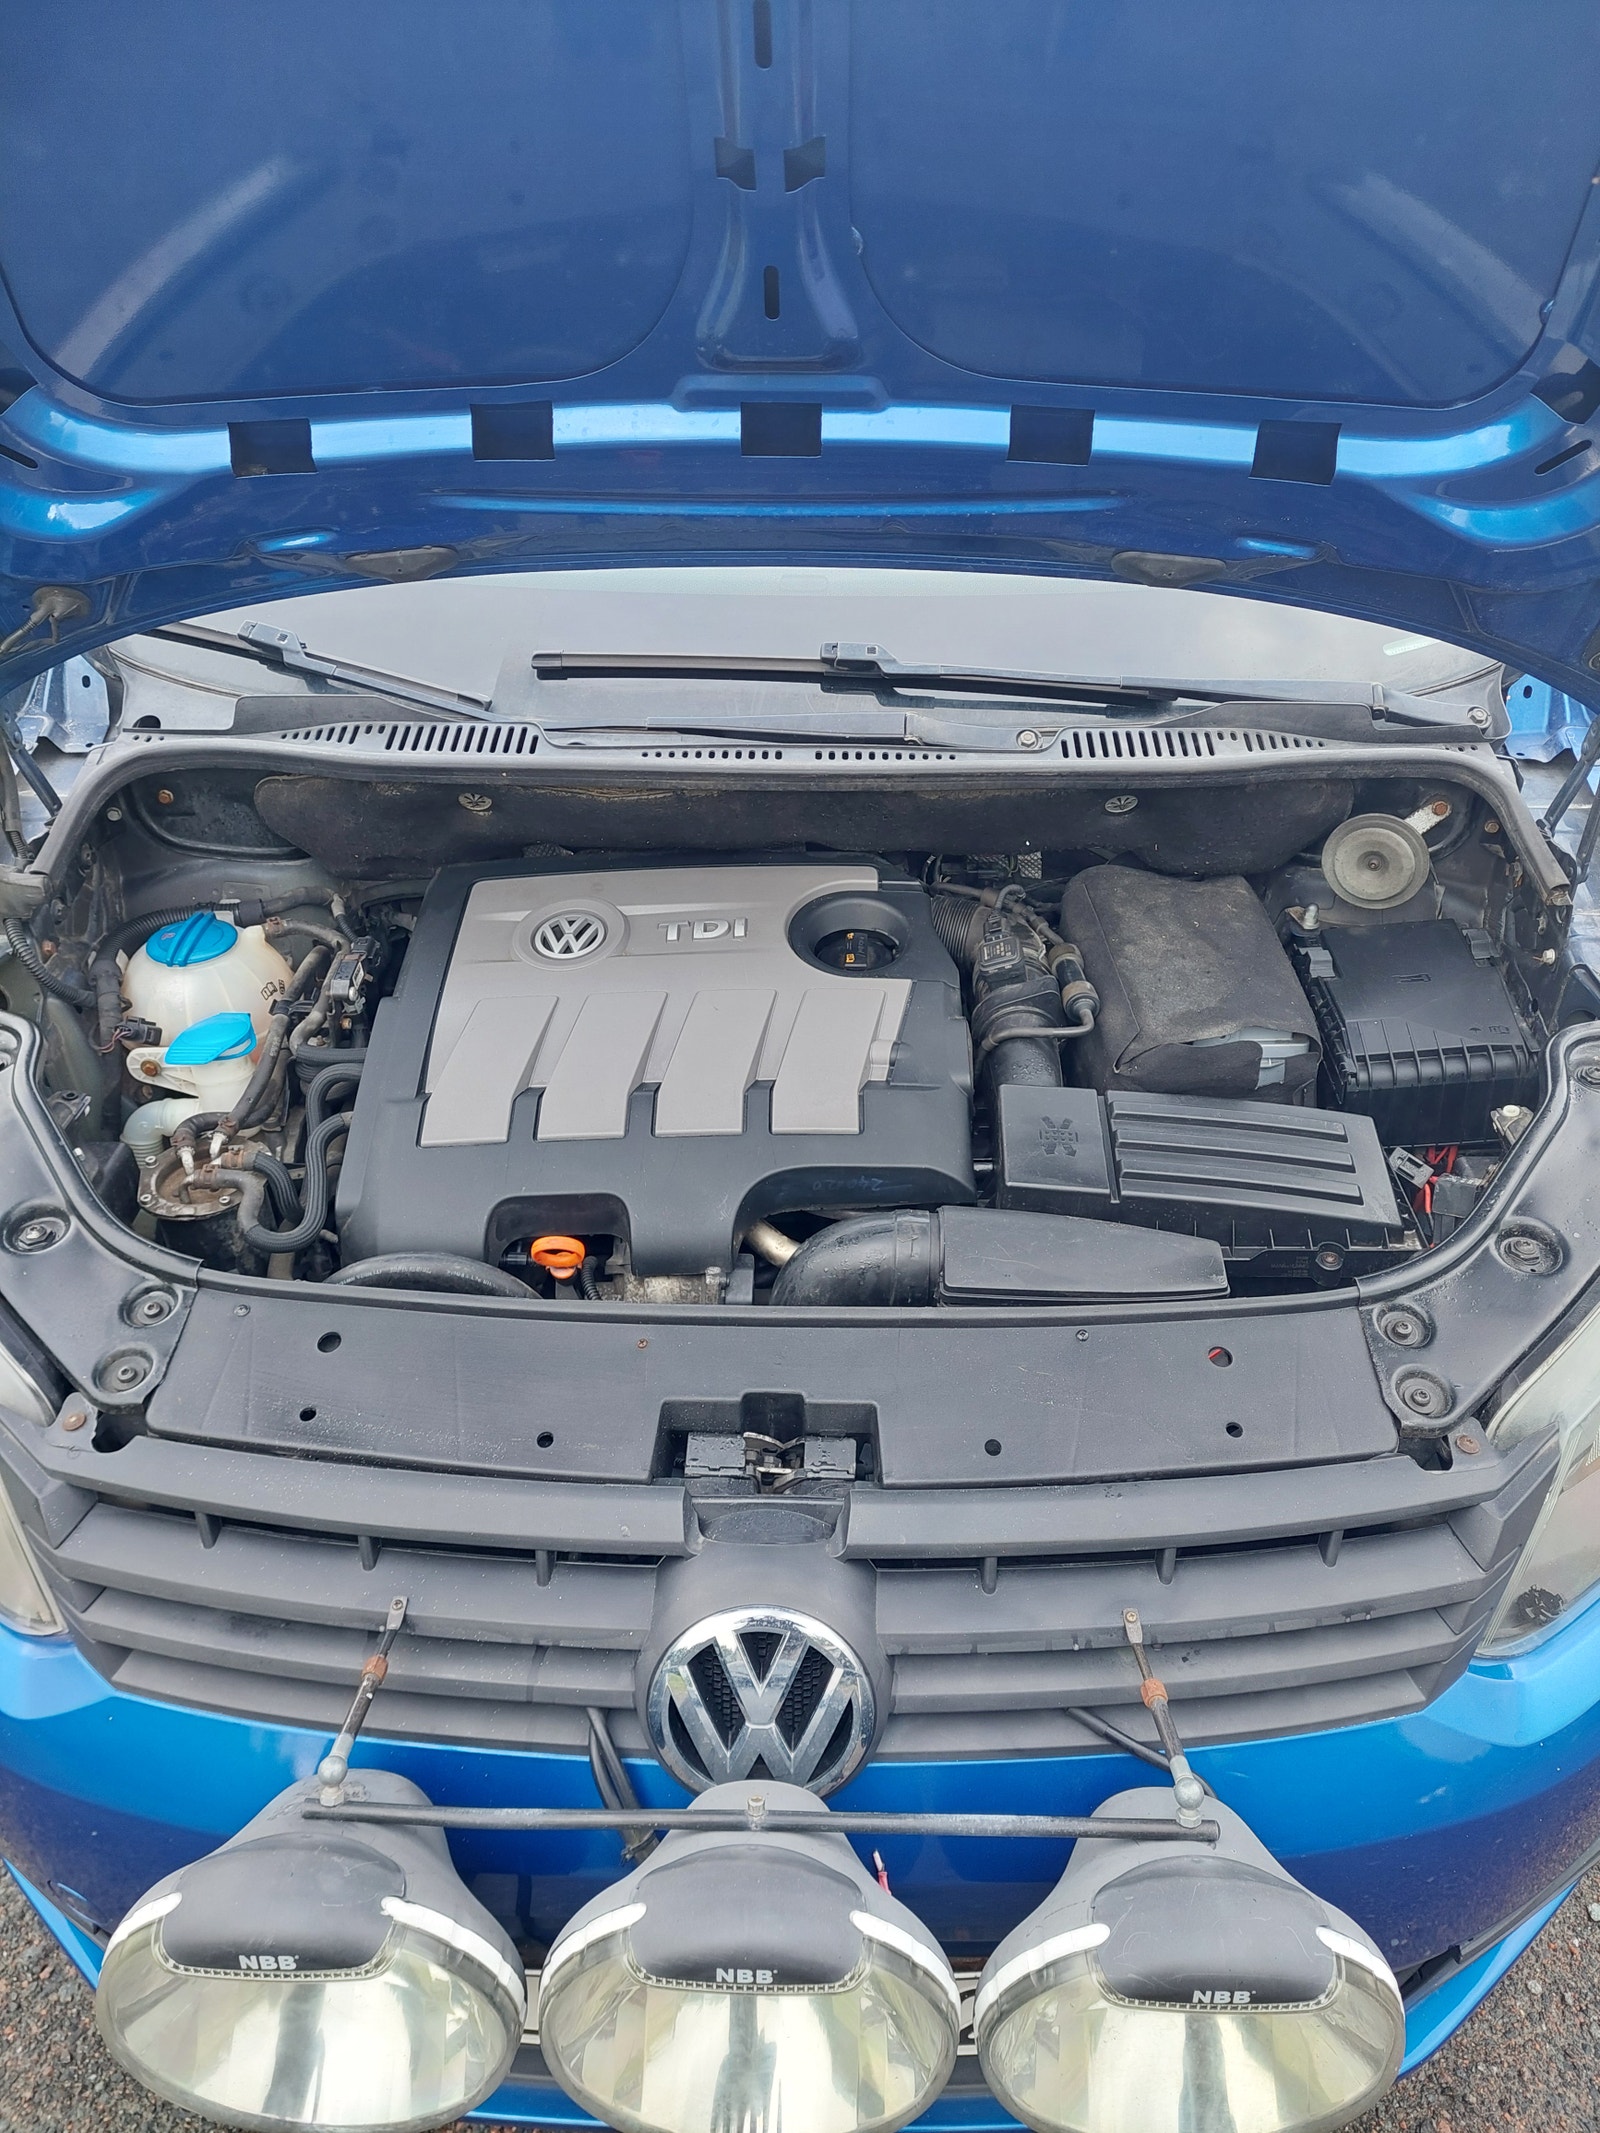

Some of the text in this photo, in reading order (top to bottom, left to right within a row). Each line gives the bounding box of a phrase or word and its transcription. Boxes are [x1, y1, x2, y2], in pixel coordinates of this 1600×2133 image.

[657, 917, 748, 943] TDI
[238, 1954, 298, 1971] NBB
[715, 1967, 775, 1985] NBB
[1191, 1989, 1253, 2005] NBB
